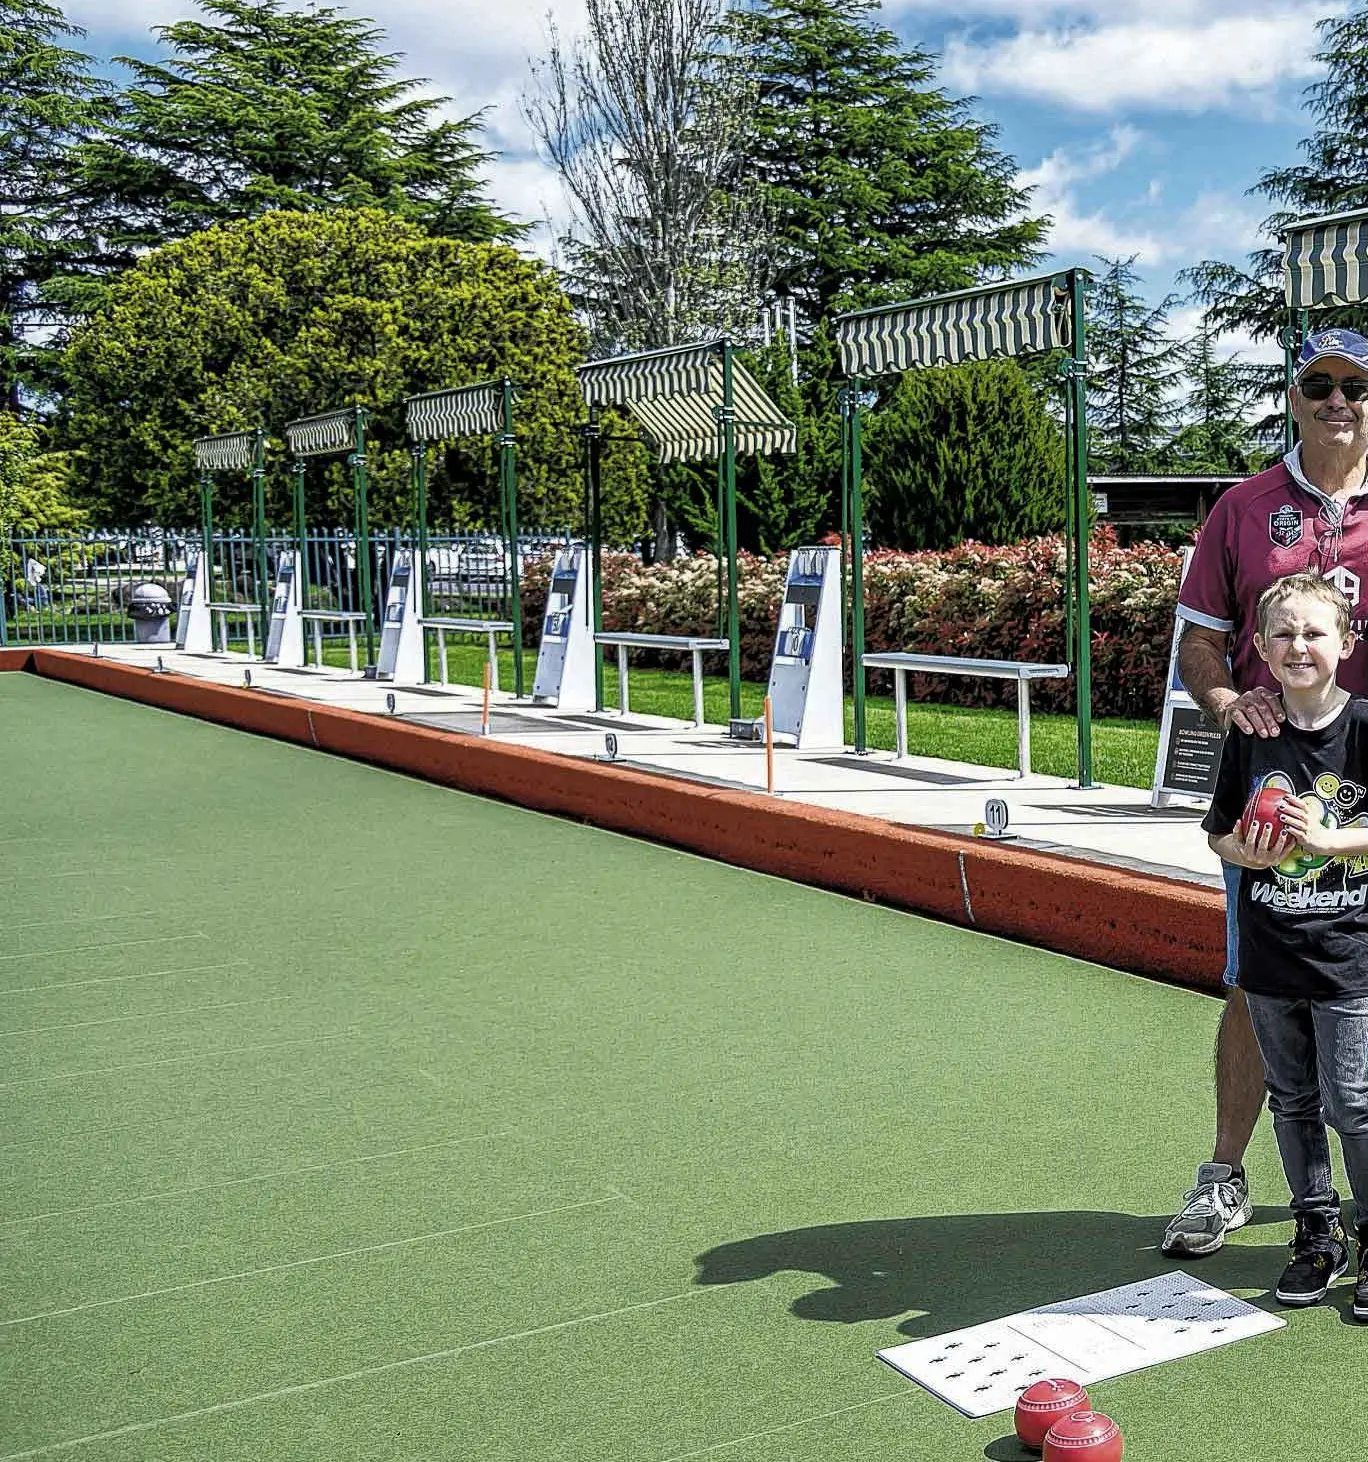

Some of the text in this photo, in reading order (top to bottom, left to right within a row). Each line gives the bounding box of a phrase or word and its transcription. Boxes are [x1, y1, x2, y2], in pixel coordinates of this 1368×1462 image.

[1272, 519, 1299, 527] ORIGIN
[990, 804, 1001, 824] 11
[1251, 881, 1368, 909] Weekend
